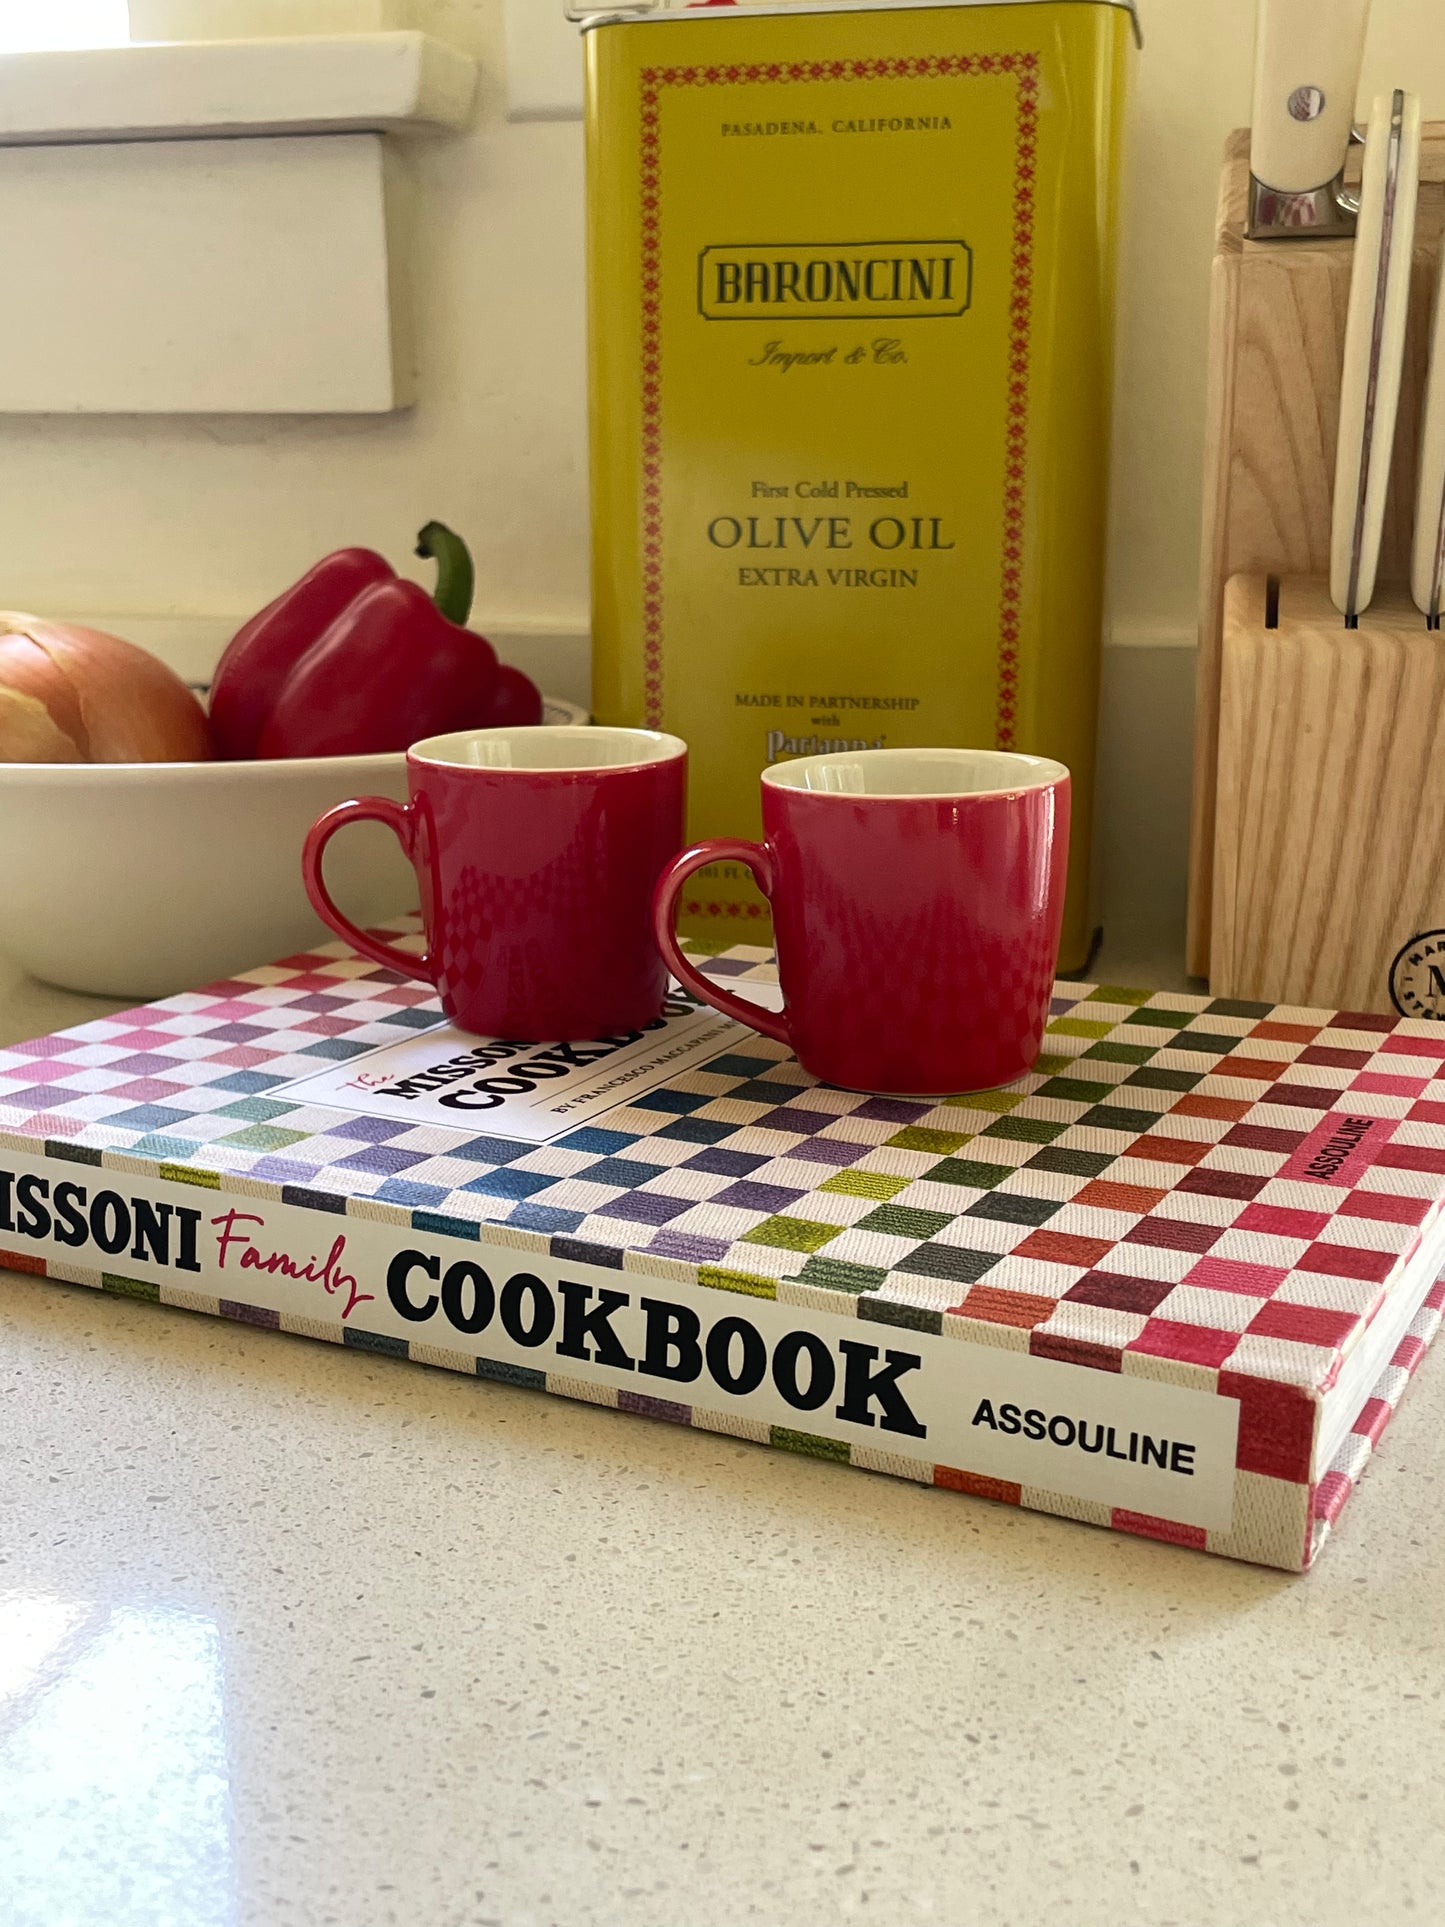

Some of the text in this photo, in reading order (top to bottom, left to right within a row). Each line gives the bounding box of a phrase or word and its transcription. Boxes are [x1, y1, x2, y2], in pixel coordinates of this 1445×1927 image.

[831, 116, 952, 133] CALIFORNIA
[714, 257, 955, 304] BARONCINI
[748, 340, 838, 373] Import
[870, 338, 908, 365] Co.
[751, 481, 909, 499] First Cold Pressed
[707, 516, 956, 550] OLIVE OIL
[738, 568, 918, 587] EXTRA VIRGIN
[735, 694, 920, 711] MADE IN PARTNERSHIP
[811, 713, 840, 727] with
[438, 986, 735, 1110] COOKOK
[373, 1040, 541, 1100] MISSO
[551, 1102, 575, 1114] BY
[572, 1063, 655, 1105] FRANCESCO
[1303, 1117, 1375, 1180] ASSOULINE
[0, 1171, 1196, 1476] ISSONI Family COOKBOOK ASSOULINE
